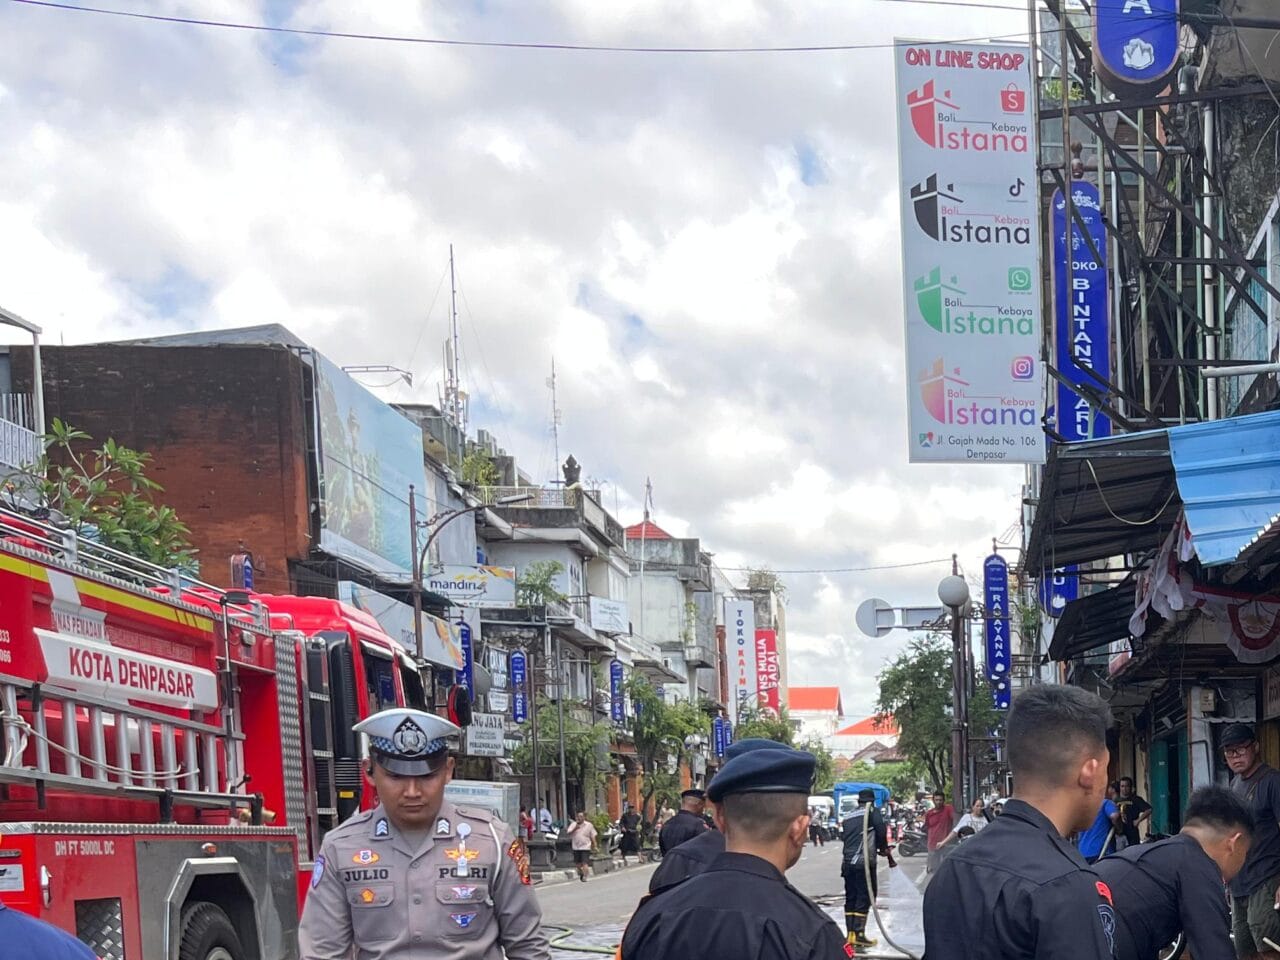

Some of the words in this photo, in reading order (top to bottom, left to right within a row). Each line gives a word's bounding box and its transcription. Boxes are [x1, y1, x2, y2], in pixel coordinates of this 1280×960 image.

[906, 48, 930, 66] ON
[936, 50, 973, 68] LINE
[977, 52, 1024, 70] SHOP
[938, 113, 956, 122] Bali
[992, 123, 1027, 134] Kebaya
[939, 124, 1028, 152] Istana
[941, 205, 959, 215] Bali
[994, 216, 1030, 225] Kebaya
[942, 217, 1030, 244] Istana
[1063, 260, 1098, 271] OKO
[944, 298, 962, 307] Bali
[997, 306, 1033, 317] Kebaya
[945, 308, 1033, 335] Istana
[947, 389, 964, 399] Bali
[1001, 398, 1035, 407] Kebaya
[948, 400, 1035, 425] Istana
[1074, 384, 1090, 436] ARU
[948, 435, 973, 447] Gajah
[977, 436, 999, 446] Mada
[1021, 436, 1036, 446] 106
[967, 449, 1007, 460] Denpasar
[430, 580, 476, 590] mandiri
[737, 609, 745, 646] TOKO
[757, 638, 767, 672] MULIA
[69, 647, 114, 683] KOTA
[118, 658, 194, 698] DENPASAR
[738, 650, 746, 687] KAIN
[68, 841, 78, 855] FT
[344, 868, 389, 882] JULIO
[439, 867, 488, 879] PORI
